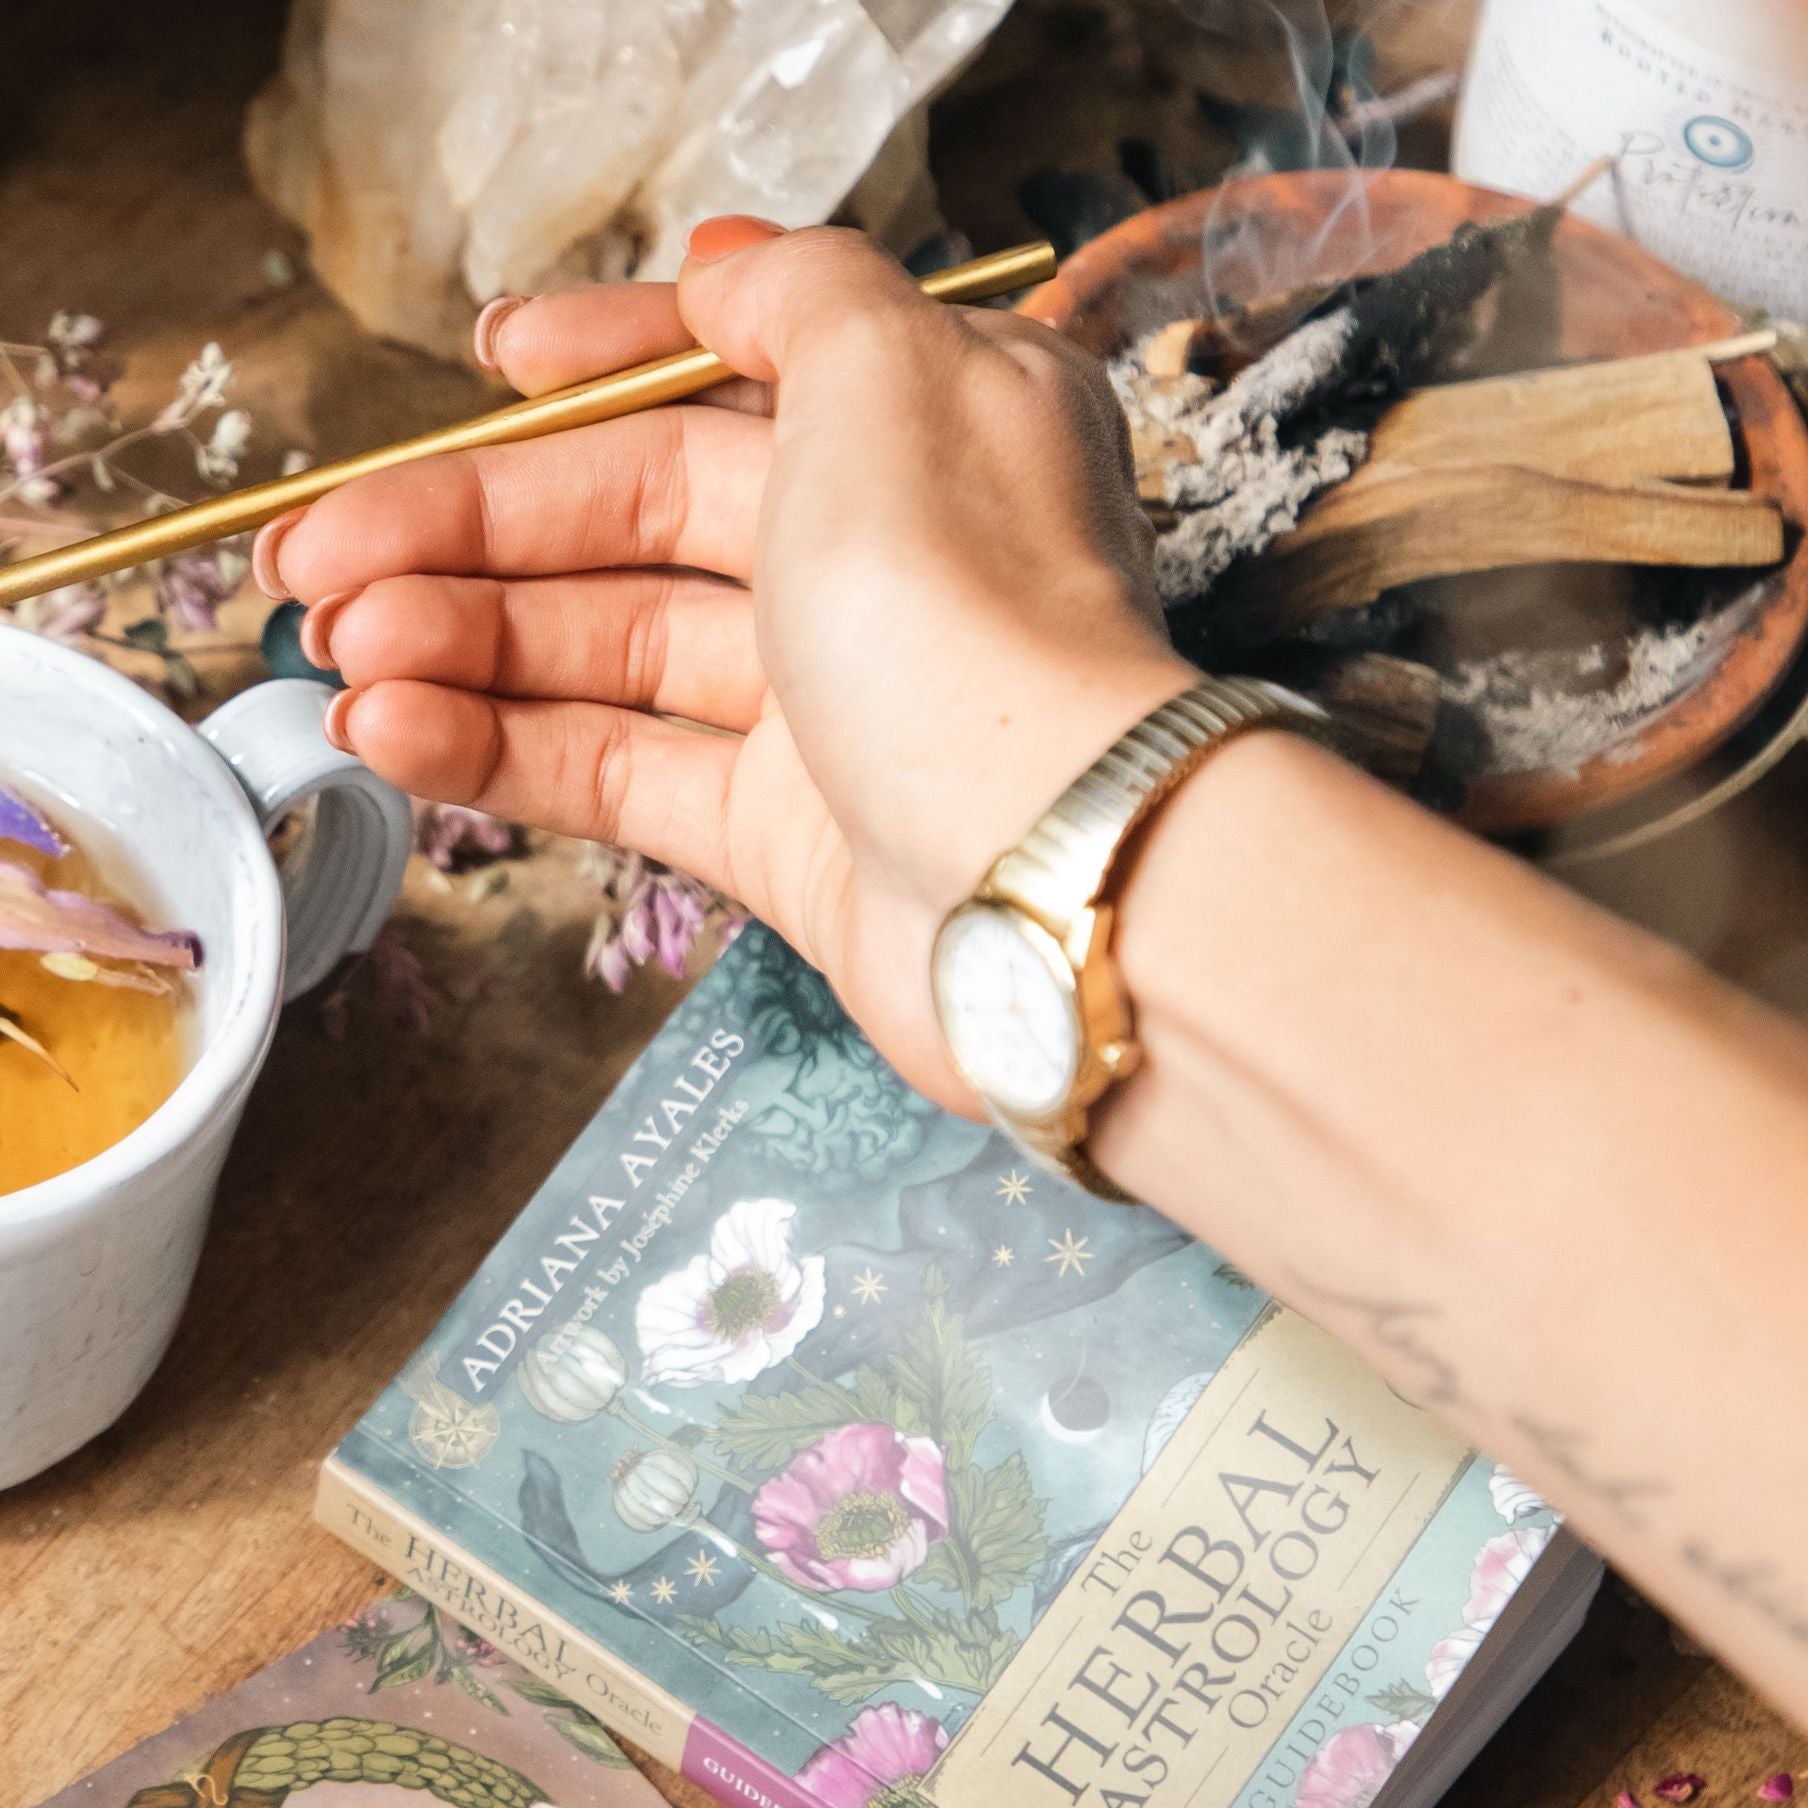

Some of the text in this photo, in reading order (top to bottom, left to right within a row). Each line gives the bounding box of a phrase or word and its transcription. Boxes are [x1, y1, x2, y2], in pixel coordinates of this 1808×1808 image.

[462, 1028, 745, 1393] ADRIANA AYALES
[536, 1284, 610, 1374] Artwork
[596, 1256, 630, 1286] by
[690, 1099, 752, 1163] Klerks
[346, 1502, 578, 1672] The HERBAL
[406, 1566, 578, 1680] ASTROLOGY
[1011, 1408, 1340, 1807] HERBAL
[1080, 1529, 1153, 1597] The
[586, 1671, 665, 1737] Oracle
[1227, 1608, 1333, 1730] Oracle
